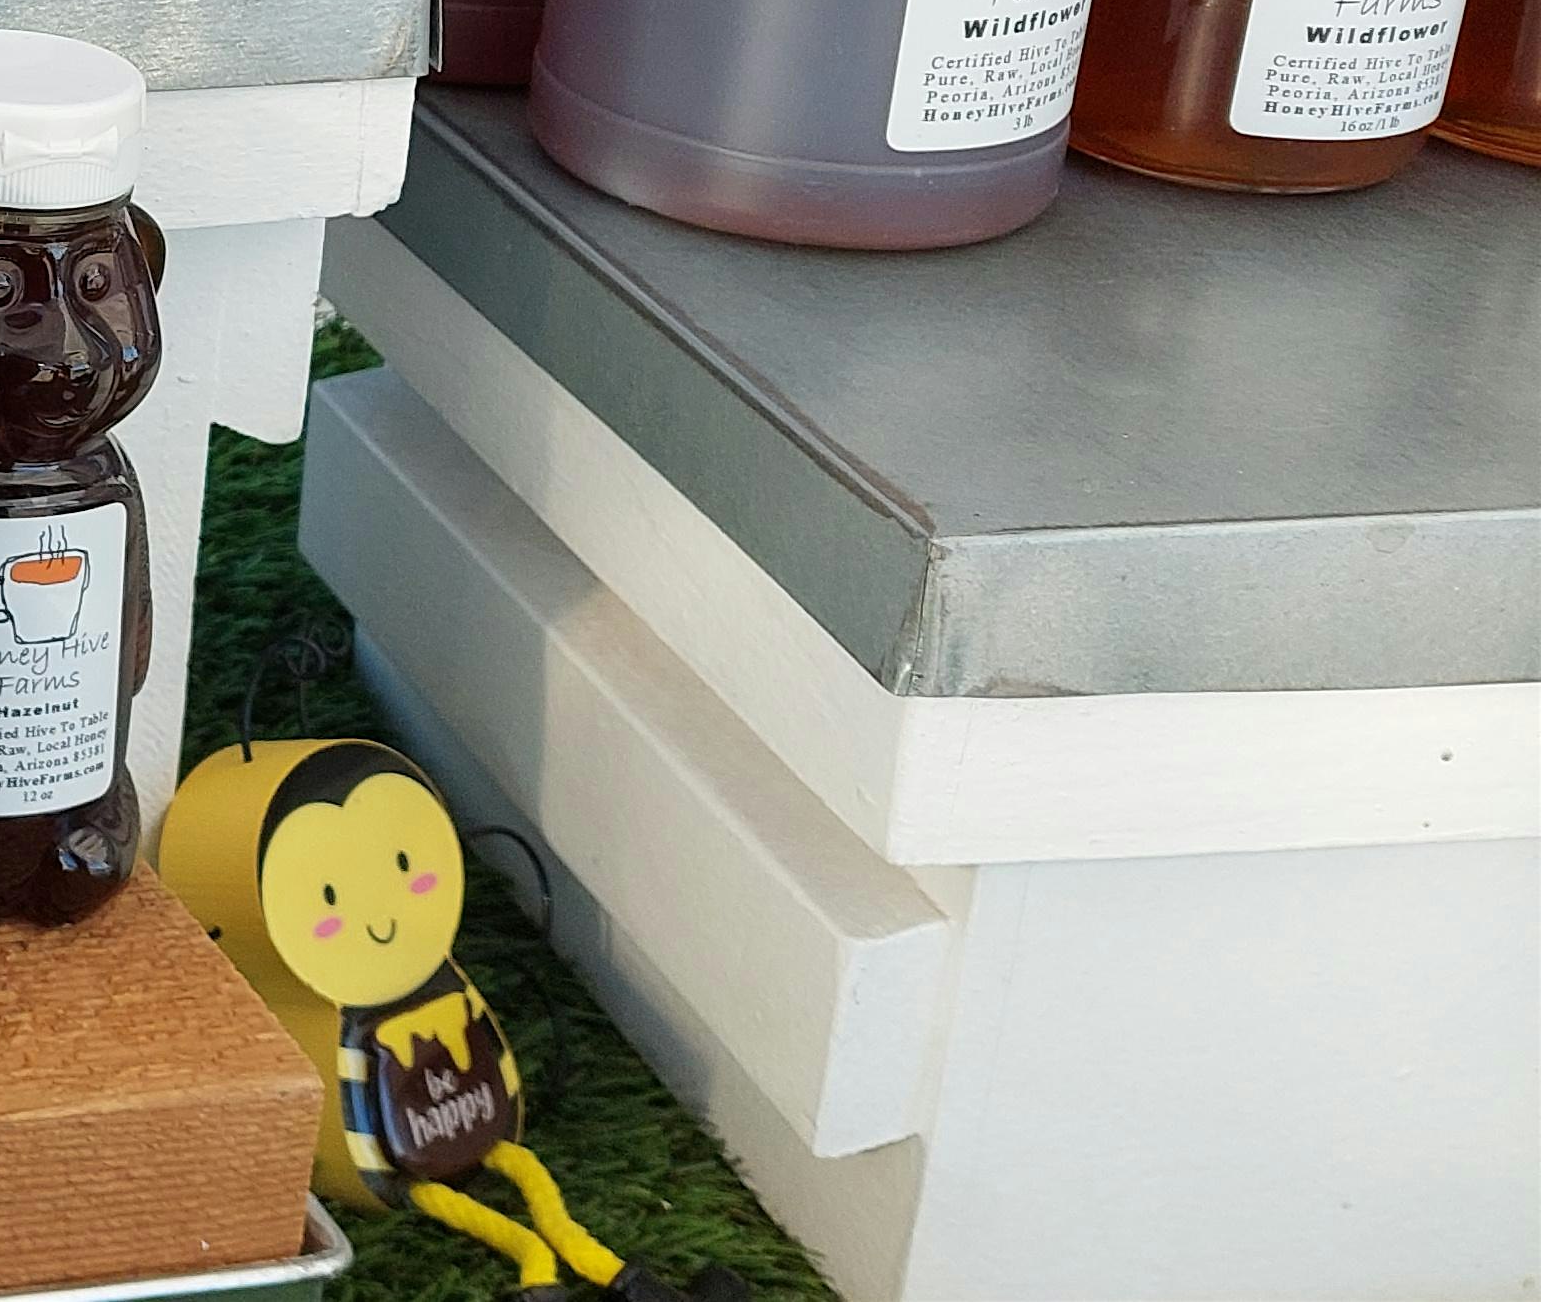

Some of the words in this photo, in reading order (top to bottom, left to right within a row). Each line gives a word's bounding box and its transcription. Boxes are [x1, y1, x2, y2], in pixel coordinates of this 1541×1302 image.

[1307, 20, 1448, 43] Wildflower
[932, 50, 1012, 69] Certified
[1019, 45, 1050, 62] Hive
[1055, 38, 1067, 51] To
[1265, 70, 1317, 85] Pure,
[1328, 73, 1370, 85] Raw,
[1378, 66, 1417, 83] Local
[62, 632, 109, 658] Hive
[424, 1068, 456, 1105] be
[406, 1082, 494, 1149] happy
